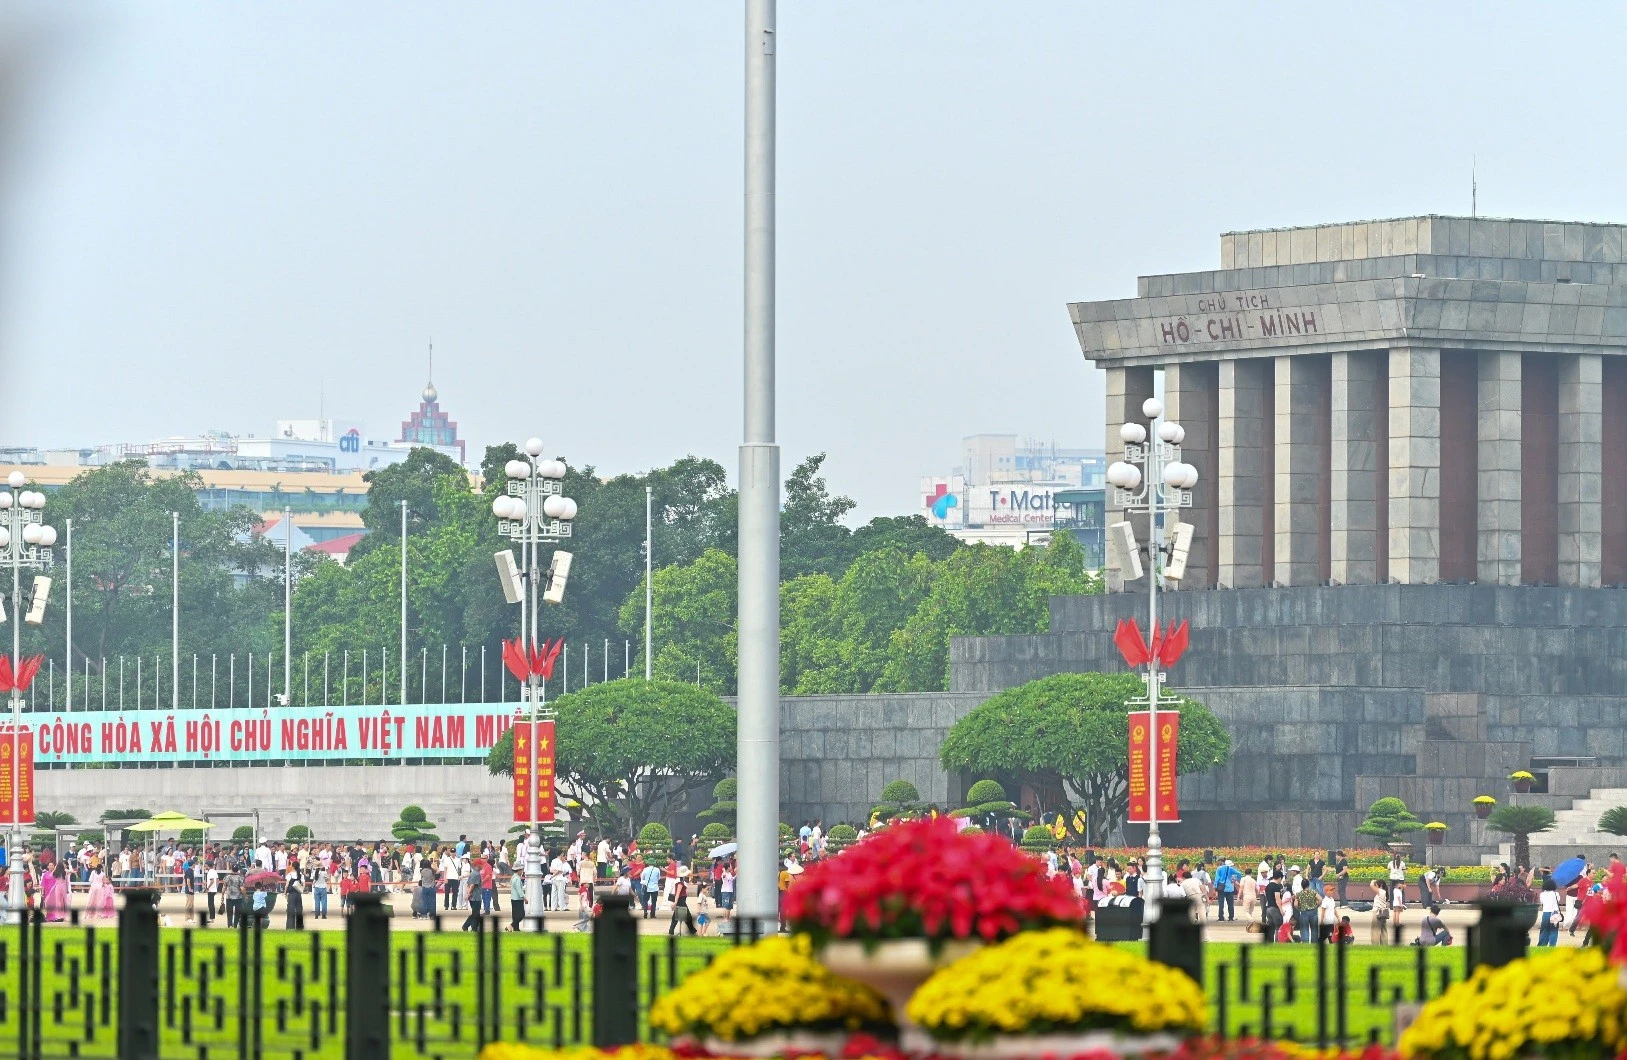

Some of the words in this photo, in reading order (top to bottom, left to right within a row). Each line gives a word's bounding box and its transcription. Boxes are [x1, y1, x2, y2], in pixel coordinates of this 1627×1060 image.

[340, 430, 359, 452] citi
[989, 514, 1021, 523] Medical
[1024, 513, 1053, 523] Center
[39, 717, 92, 759] CỘNG
[102, 716, 142, 753] HÒA
[151, 715, 177, 753] XÃ
[187, 714, 221, 759] HỘI
[231, 709, 271, 751] CHỦ
[282, 712, 347, 751] NGHĨA
[358, 710, 405, 755] VIỆT
[416, 715, 465, 748] NAM
